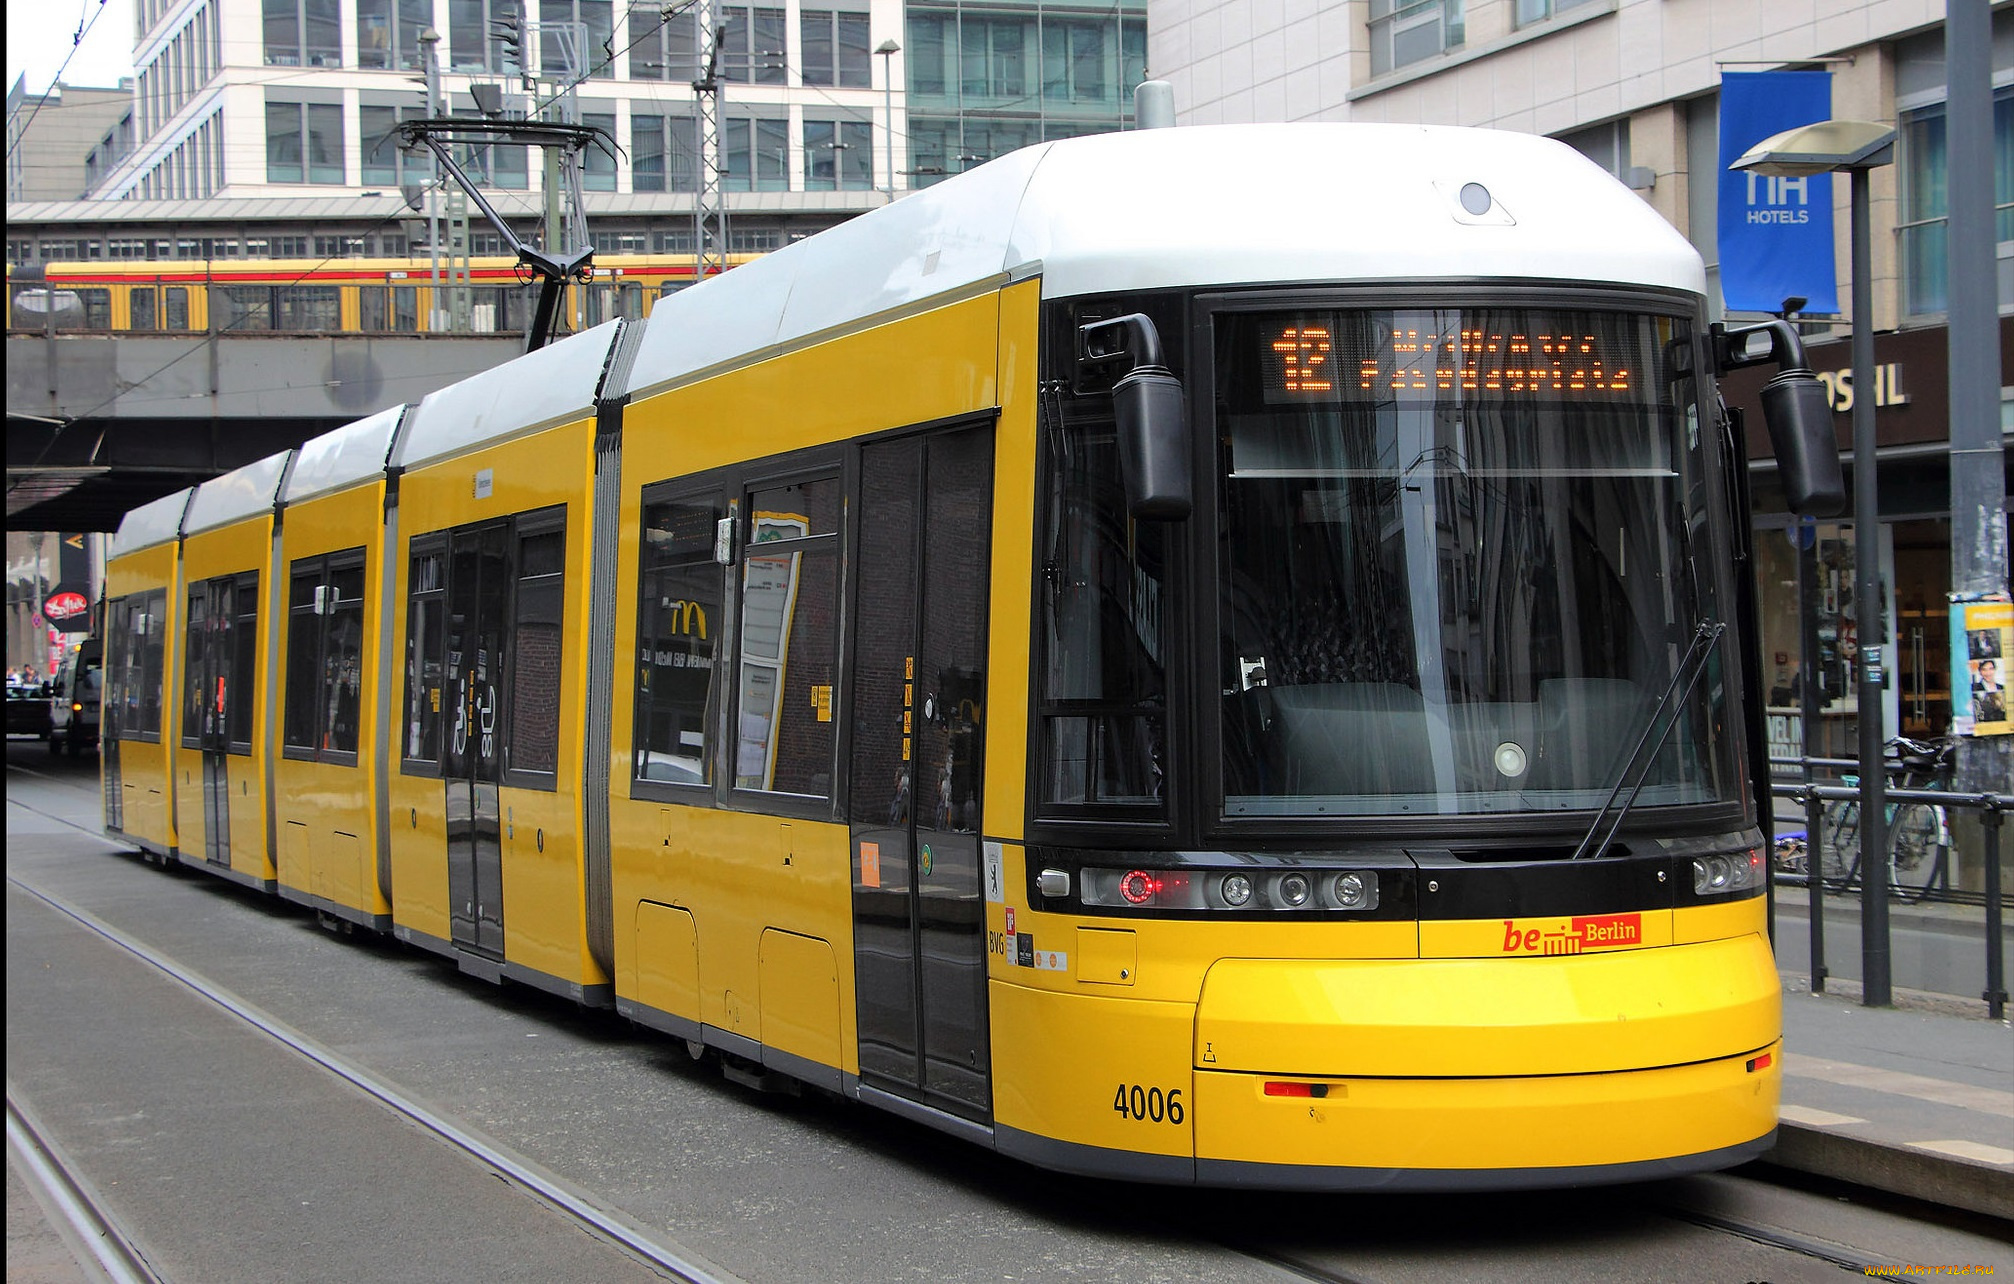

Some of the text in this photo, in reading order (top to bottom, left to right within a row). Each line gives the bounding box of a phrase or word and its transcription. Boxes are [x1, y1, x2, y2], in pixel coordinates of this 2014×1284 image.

[1747, 210, 1809, 224] HOTELS
[1273, 329, 1331, 390] 12
[990, 931, 1004, 955] BVG
[1503, 920, 1636, 952] be Berlin
[1113, 1083, 1185, 1125] 4006
